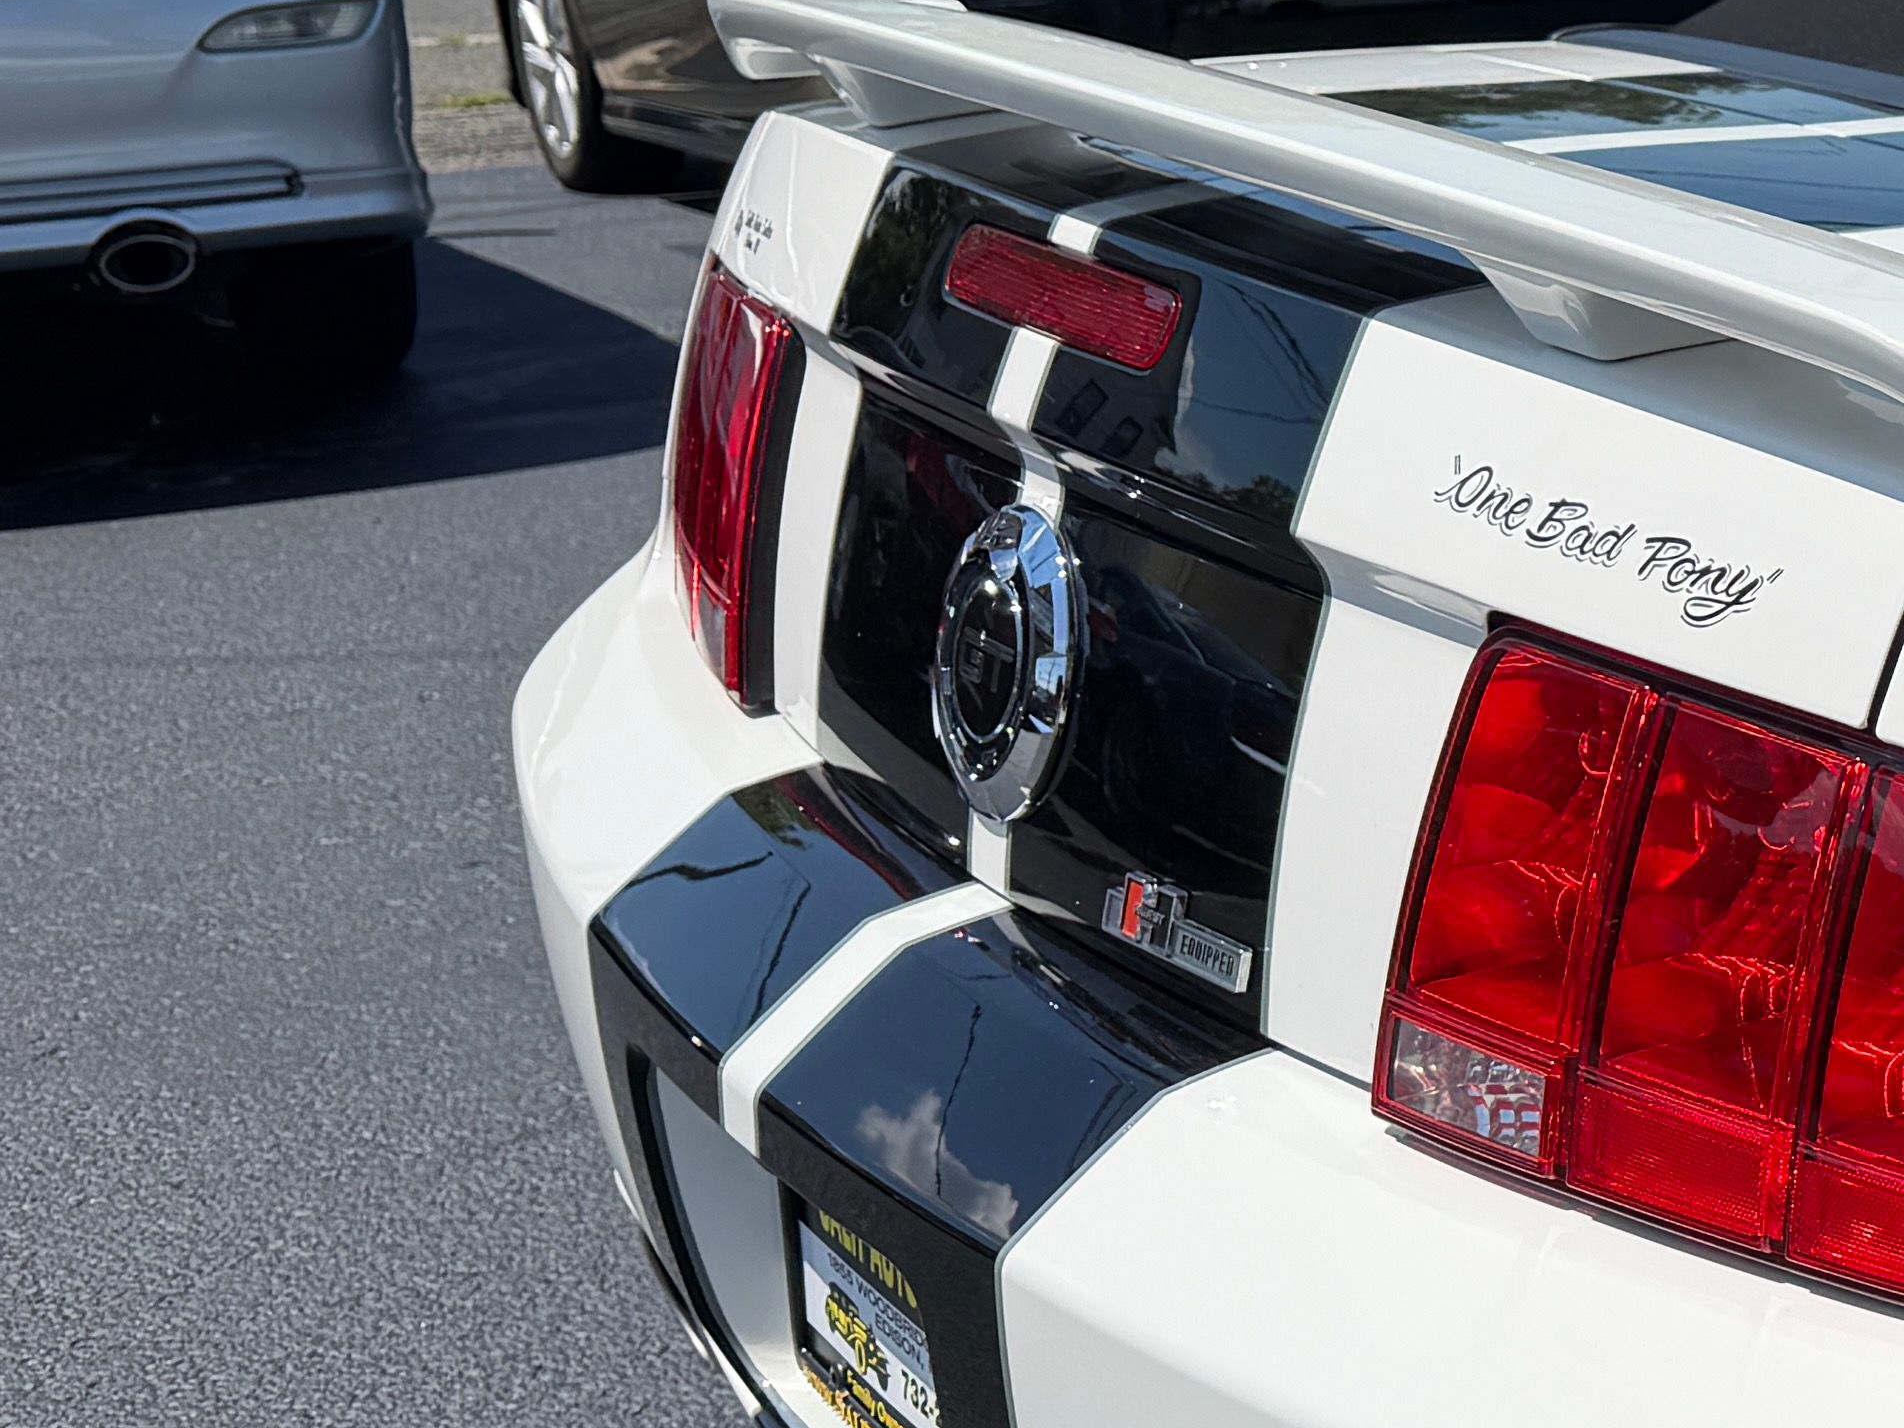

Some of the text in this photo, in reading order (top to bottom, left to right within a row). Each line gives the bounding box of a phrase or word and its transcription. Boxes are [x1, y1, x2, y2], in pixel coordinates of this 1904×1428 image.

[1524, 498, 1638, 567] Bad
[960, 626, 1017, 694] GT
[1179, 934, 1235, 977] EQUIPPED
[826, 1251, 854, 1286] 1855
[854, 1279, 928, 1348] WOODBRID
